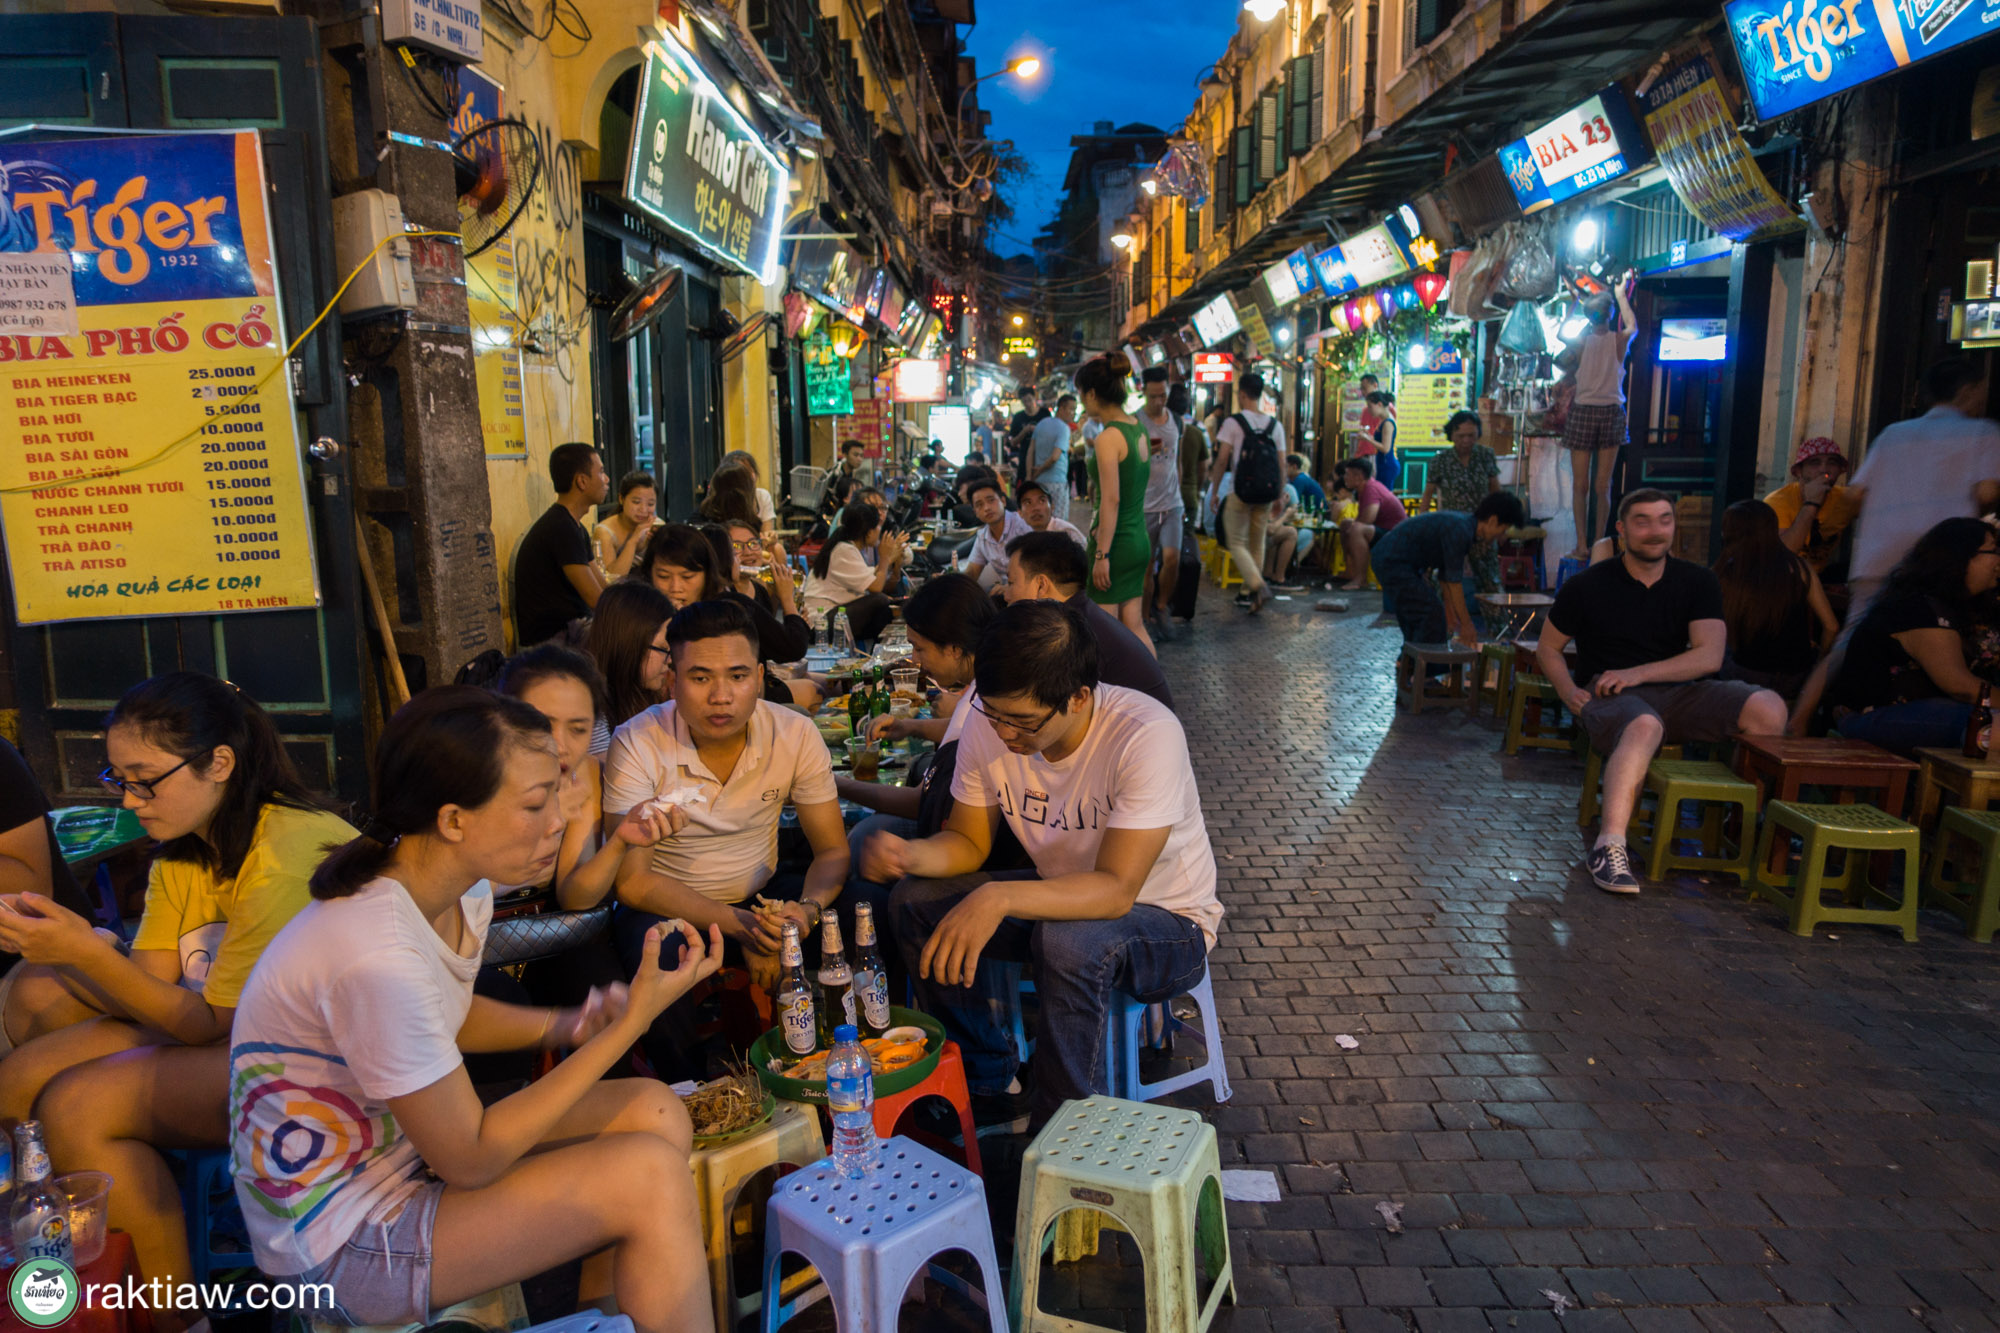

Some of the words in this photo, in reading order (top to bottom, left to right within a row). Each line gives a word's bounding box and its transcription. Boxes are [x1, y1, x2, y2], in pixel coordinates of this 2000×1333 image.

[1757, 0, 1865, 82] Tiger
[1781, 68, 1803, 84] SINCE
[1580, 114, 1612, 147] 23
[686, 90, 743, 195] Hanoi
[740, 144, 770, 219] Gift
[1509, 154, 1537, 192] Tiger
[694, 177, 732, 248] 하노이
[730, 208, 753, 263] 선물
[13, 175, 227, 285] Tiger
[160, 254, 199, 267] 1932
[1671, 244, 1686, 263] 23
[26, 299, 45, 311] 932
[47, 299, 67, 311] 678
[83, 312, 190, 357] PHỐ
[203, 305, 273, 350] CỔ
[12, 378, 42, 389] BIA
[46, 373, 132, 387] HEINEKEN
[15, 397, 45, 408] BIA
[49, 393, 99, 406] TIGER
[103, 391, 137, 405] BẠC
[18, 415, 48, 427] BIA
[22, 434, 52, 445] BIA
[25, 452, 55, 464] BIA
[28, 470, 57, 482] BIA
[84, 484, 142, 497] CHANH
[35, 505, 93, 518] CHANH
[98, 503, 129, 515] LEO
[37, 523, 70, 536] TRÀ
[75, 521, 133, 534] CHANH
[40, 541, 73, 554] TRÀ
[43, 559, 75, 572] TRÀ
[80, 557, 127, 570] ATISO
[116, 575, 160, 597] QUẢ
[166, 574, 209, 592] CÁC
[216, 575, 262, 592] LOẠI
[218, 600, 234, 610] 18
[1024, 787, 1047, 799] ONCE
[997, 782, 1114, 831] AGAIN
